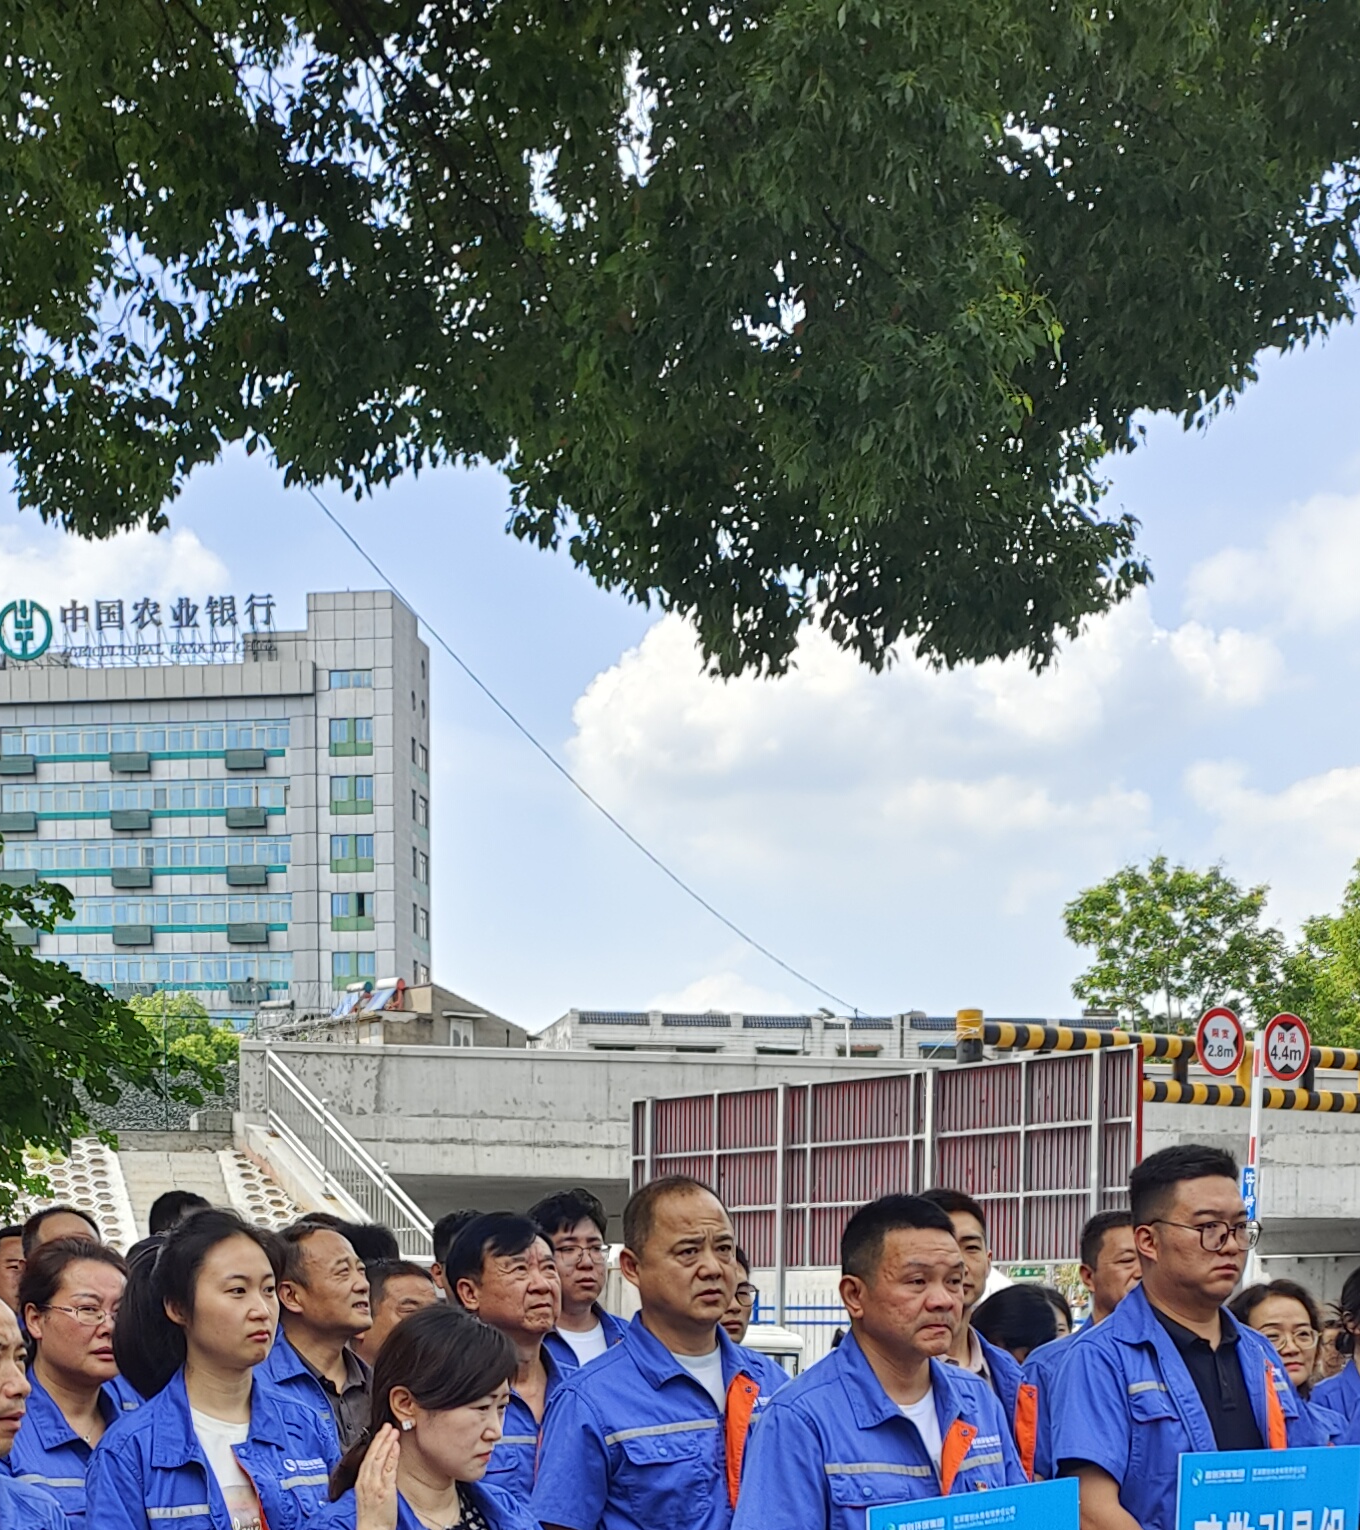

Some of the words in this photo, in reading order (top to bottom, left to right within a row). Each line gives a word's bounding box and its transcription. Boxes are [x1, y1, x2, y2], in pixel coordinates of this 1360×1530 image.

[60, 593, 277, 632] 中国农业银行
[1278, 1032, 1297, 1043] 限高
[1208, 1045, 1234, 1058] 2.8m
[1270, 1045, 1301, 1061] 4.4m
